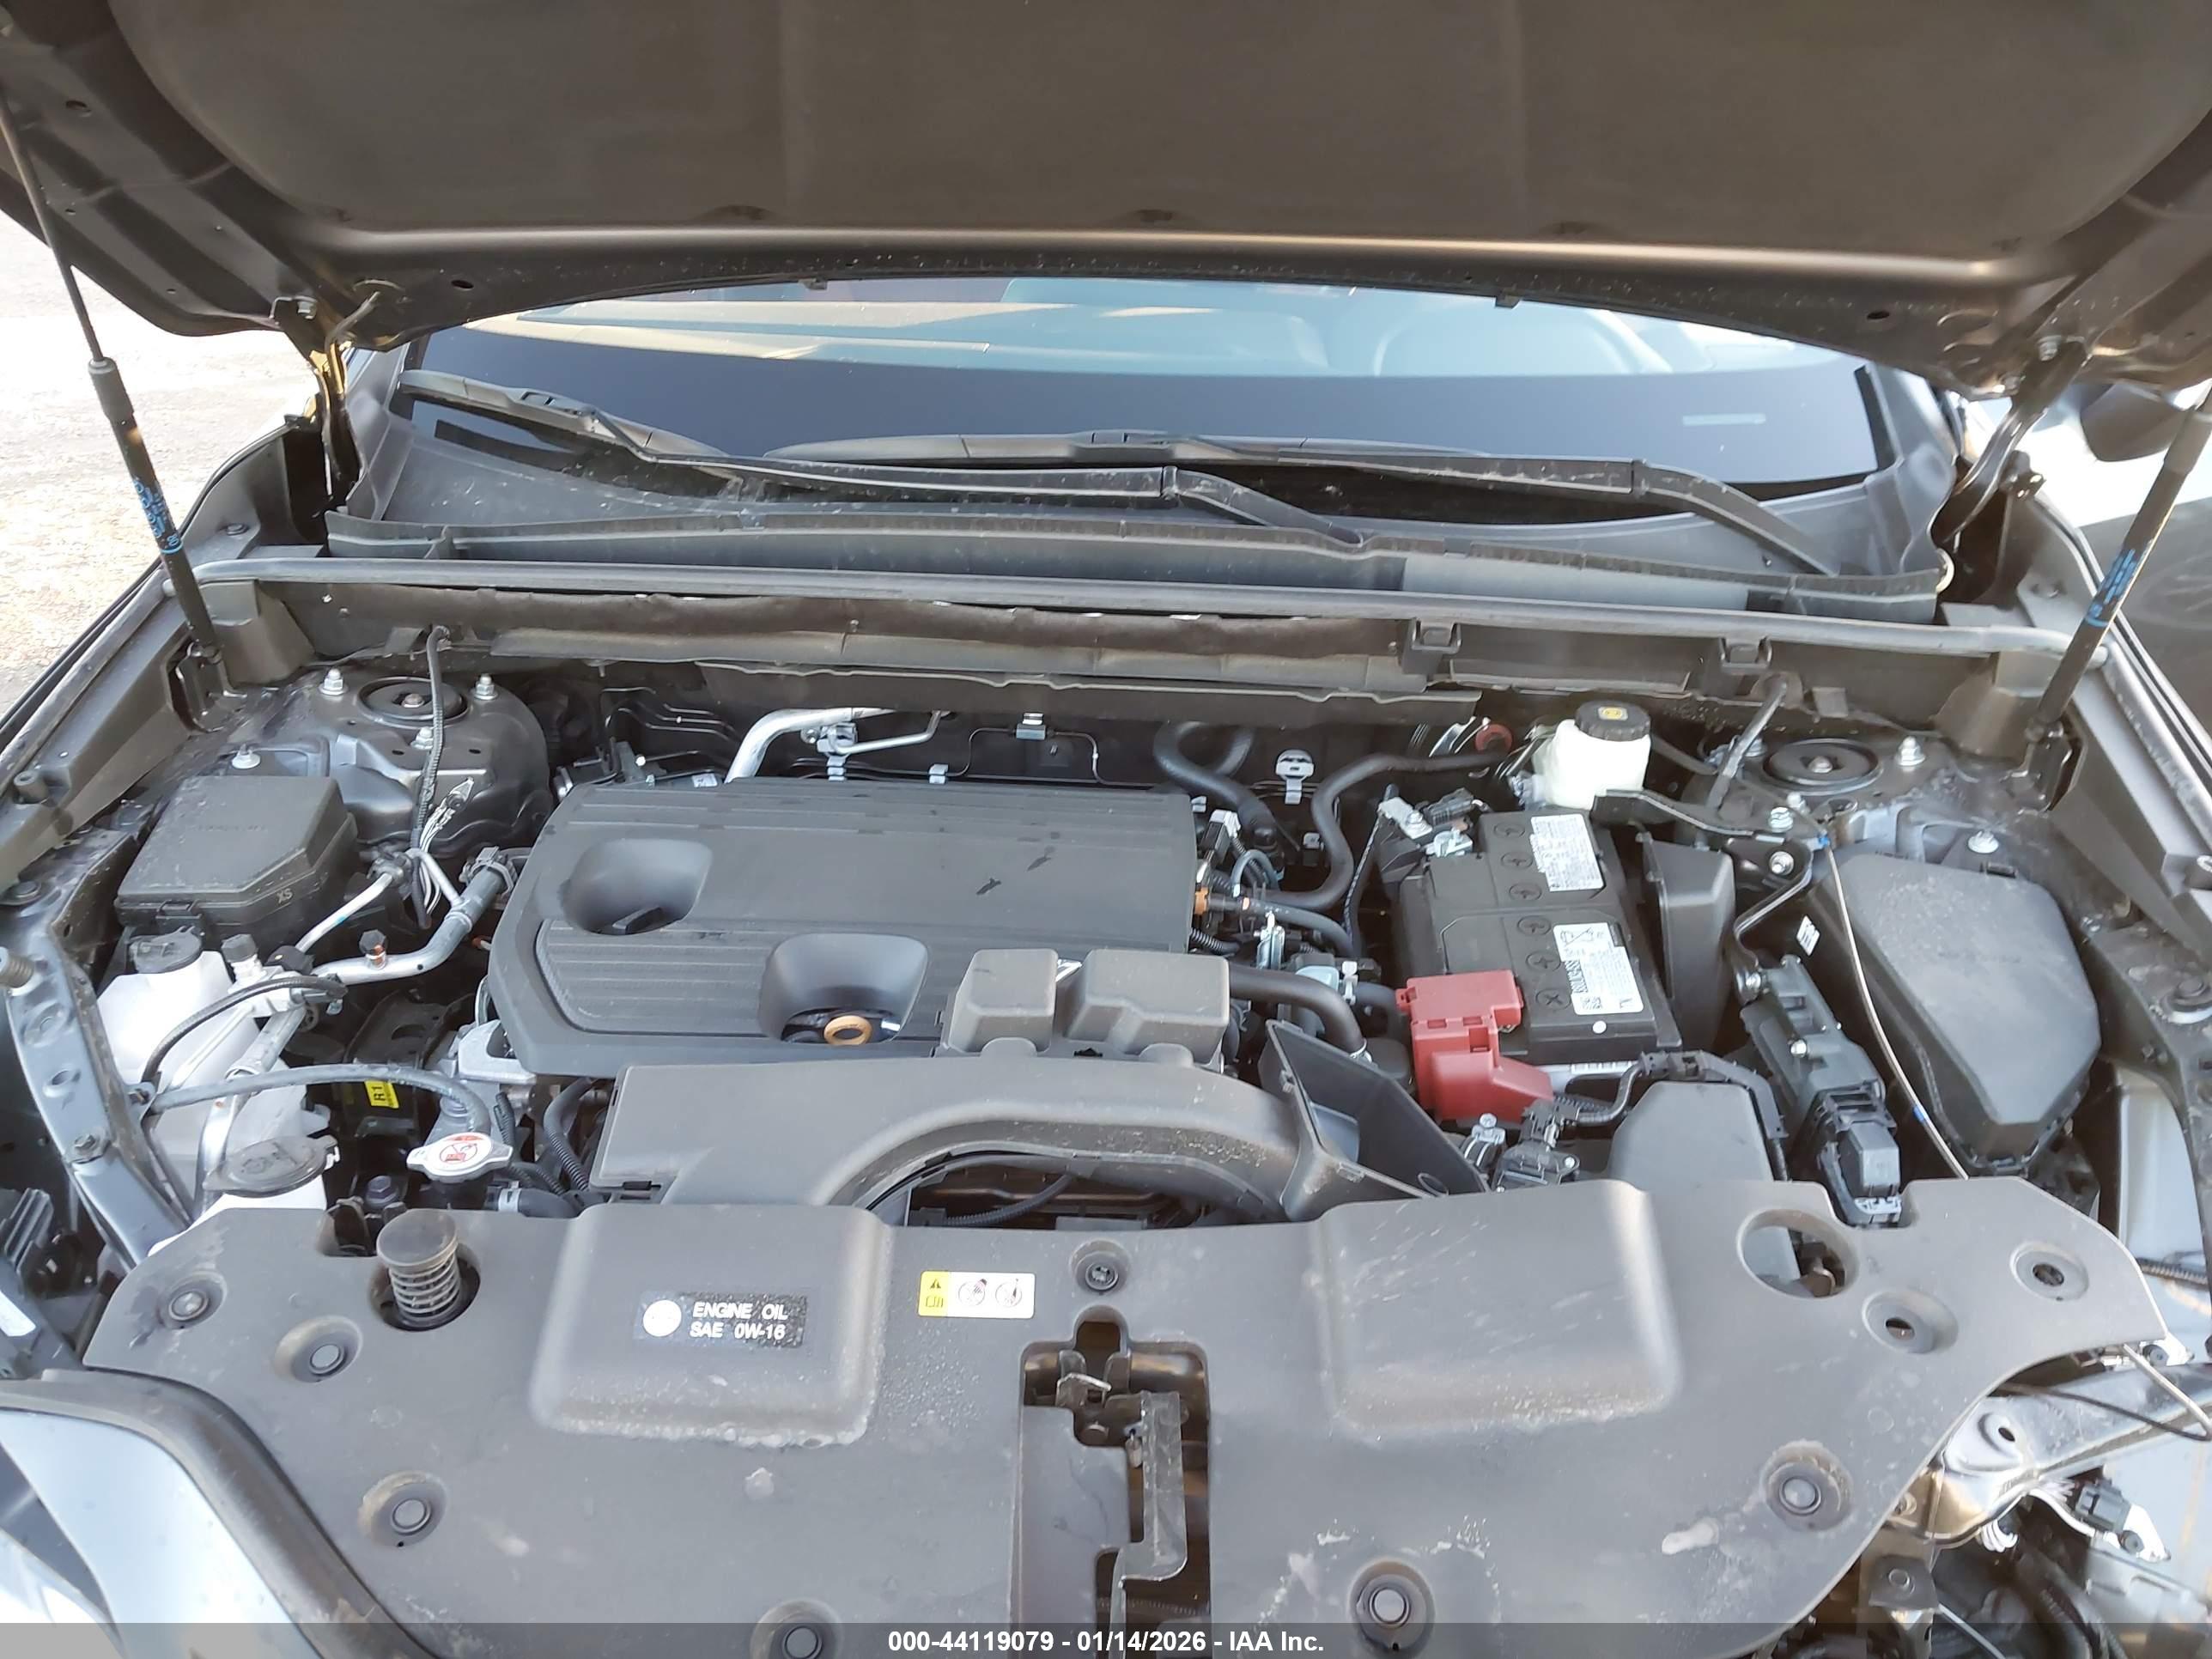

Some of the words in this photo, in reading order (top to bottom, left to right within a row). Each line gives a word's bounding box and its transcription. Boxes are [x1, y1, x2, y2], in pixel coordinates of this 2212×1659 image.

[371, 1085, 386, 1102] R1
[692, 1301, 753, 1319] ENGINE
[761, 1304, 788, 1321] OIL
[690, 1321, 724, 1338] SAE
[734, 1322, 786, 1340] 0W-16
